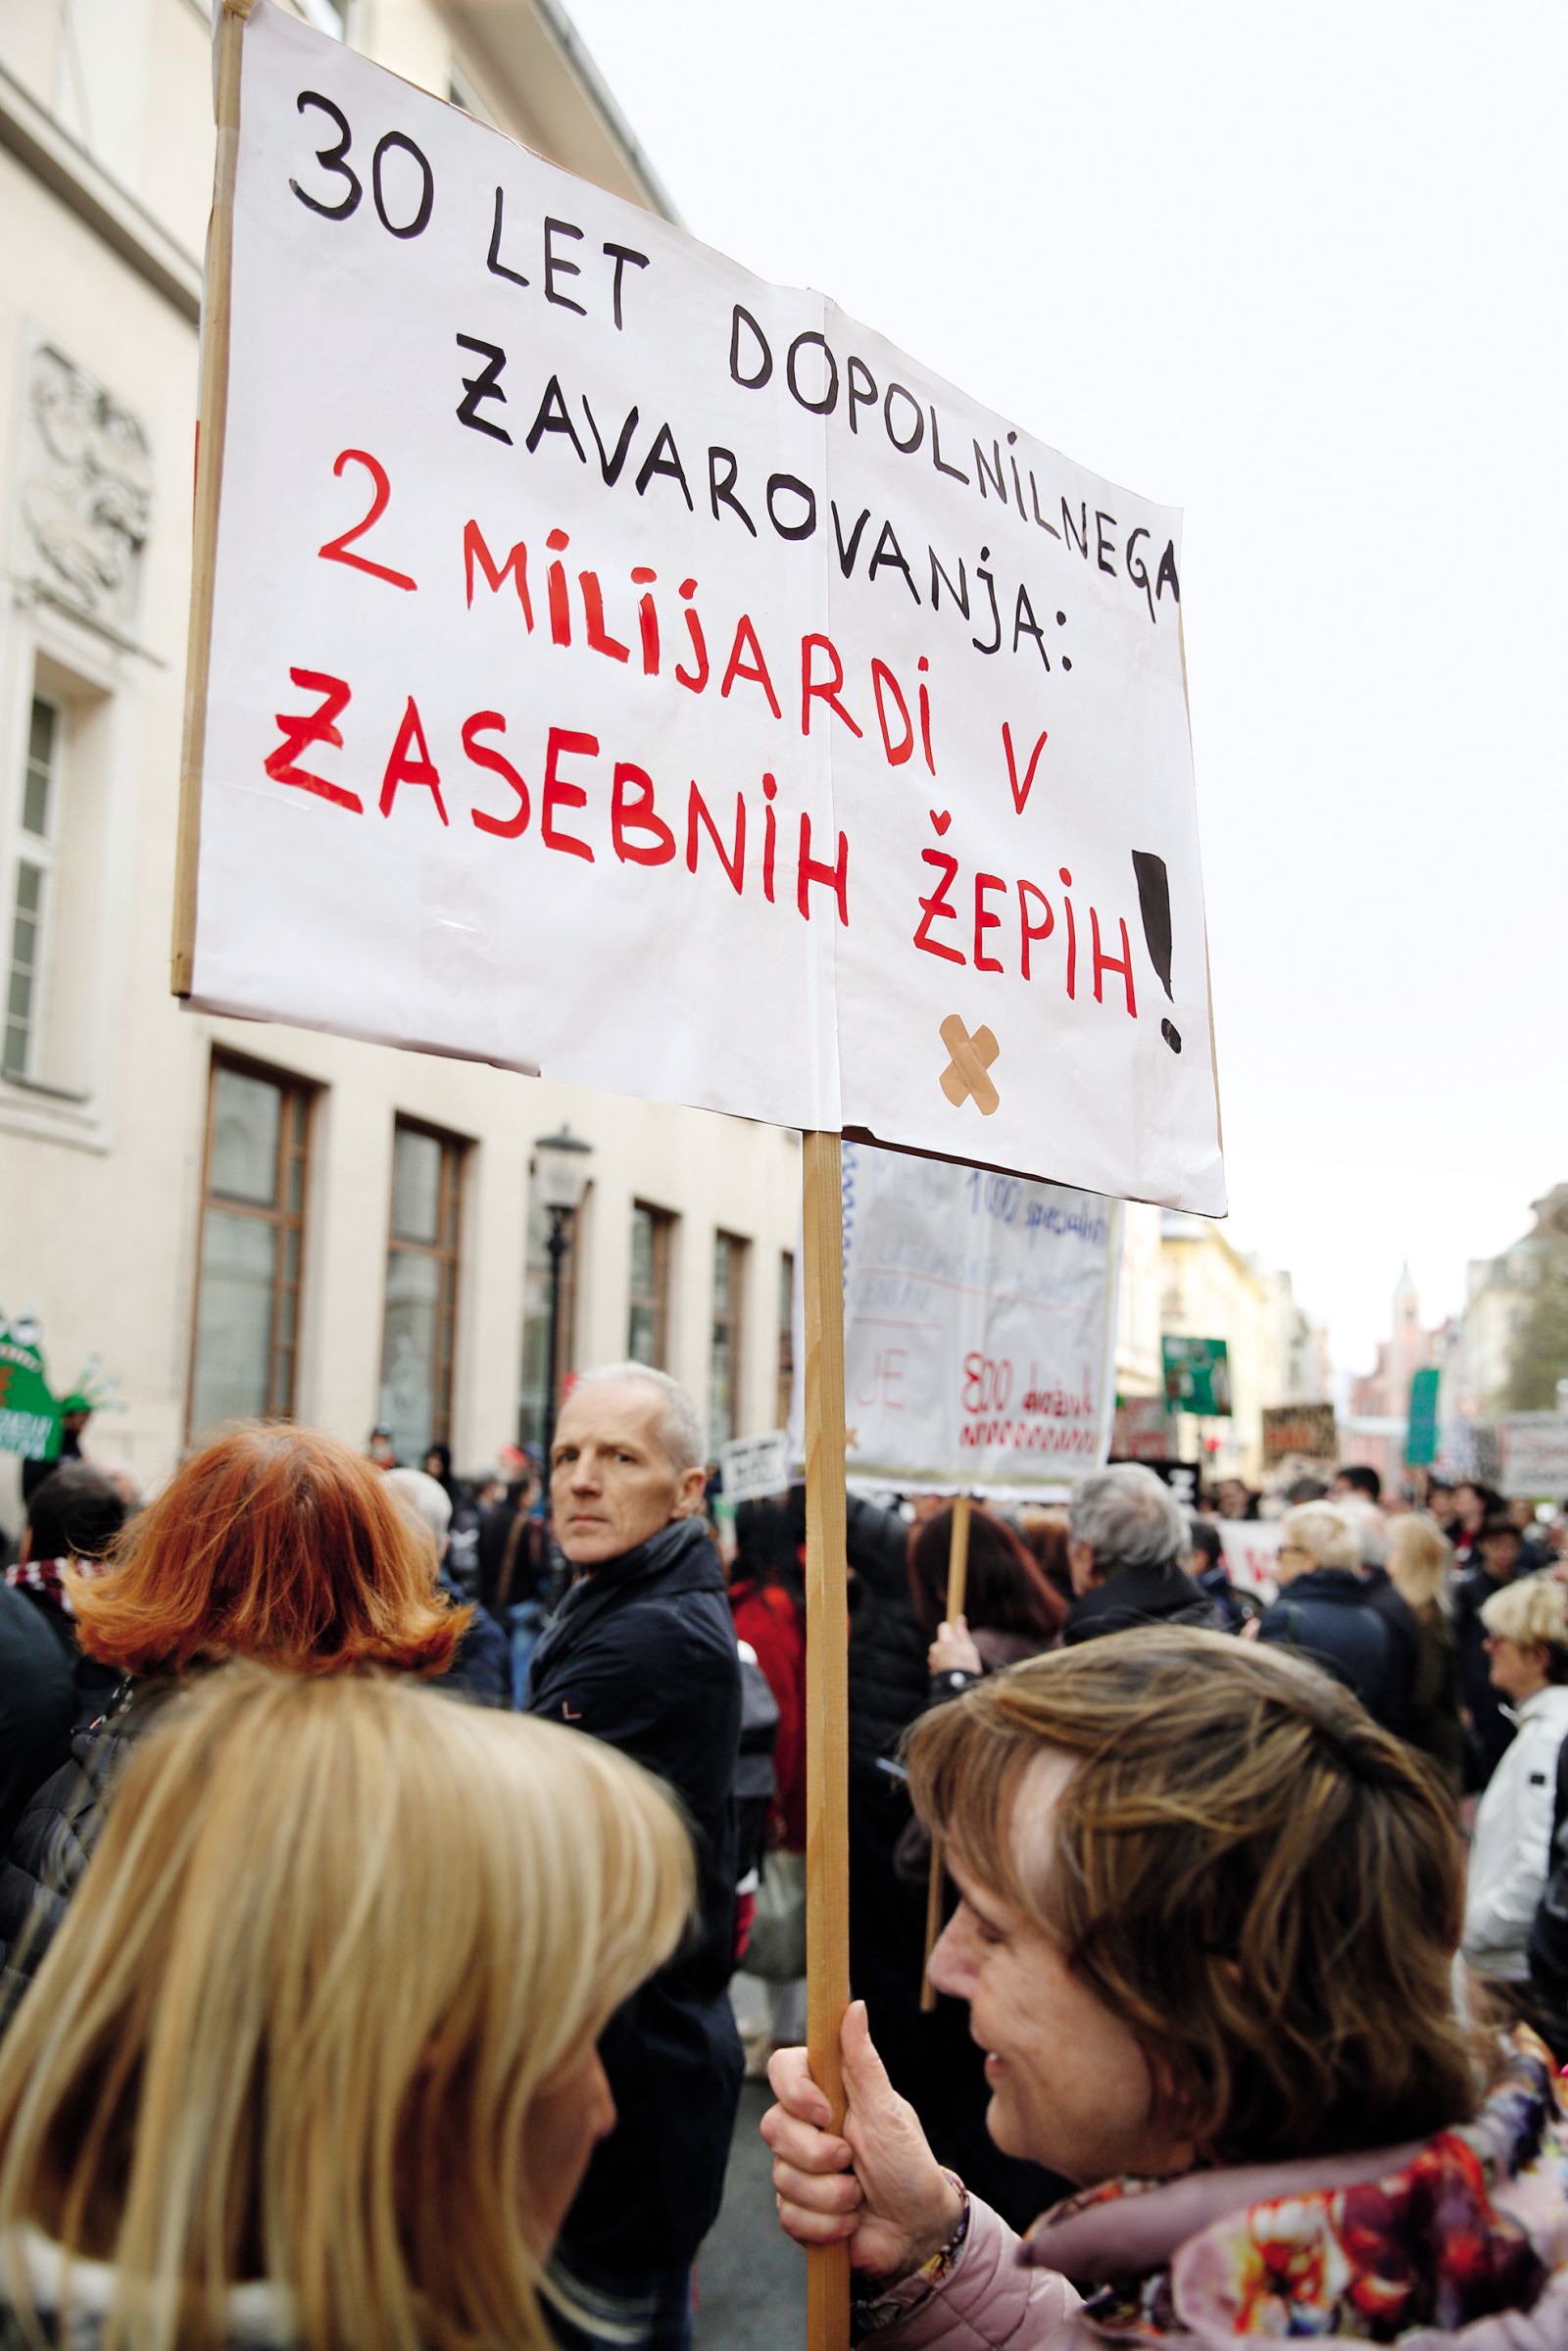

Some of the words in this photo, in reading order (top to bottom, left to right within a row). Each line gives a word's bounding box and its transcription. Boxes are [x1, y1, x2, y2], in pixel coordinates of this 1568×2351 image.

[289, 90, 434, 239] 30
[486, 186, 651, 331] LET
[318, 448, 418, 591] 2
[1002, 721, 1049, 815] V
